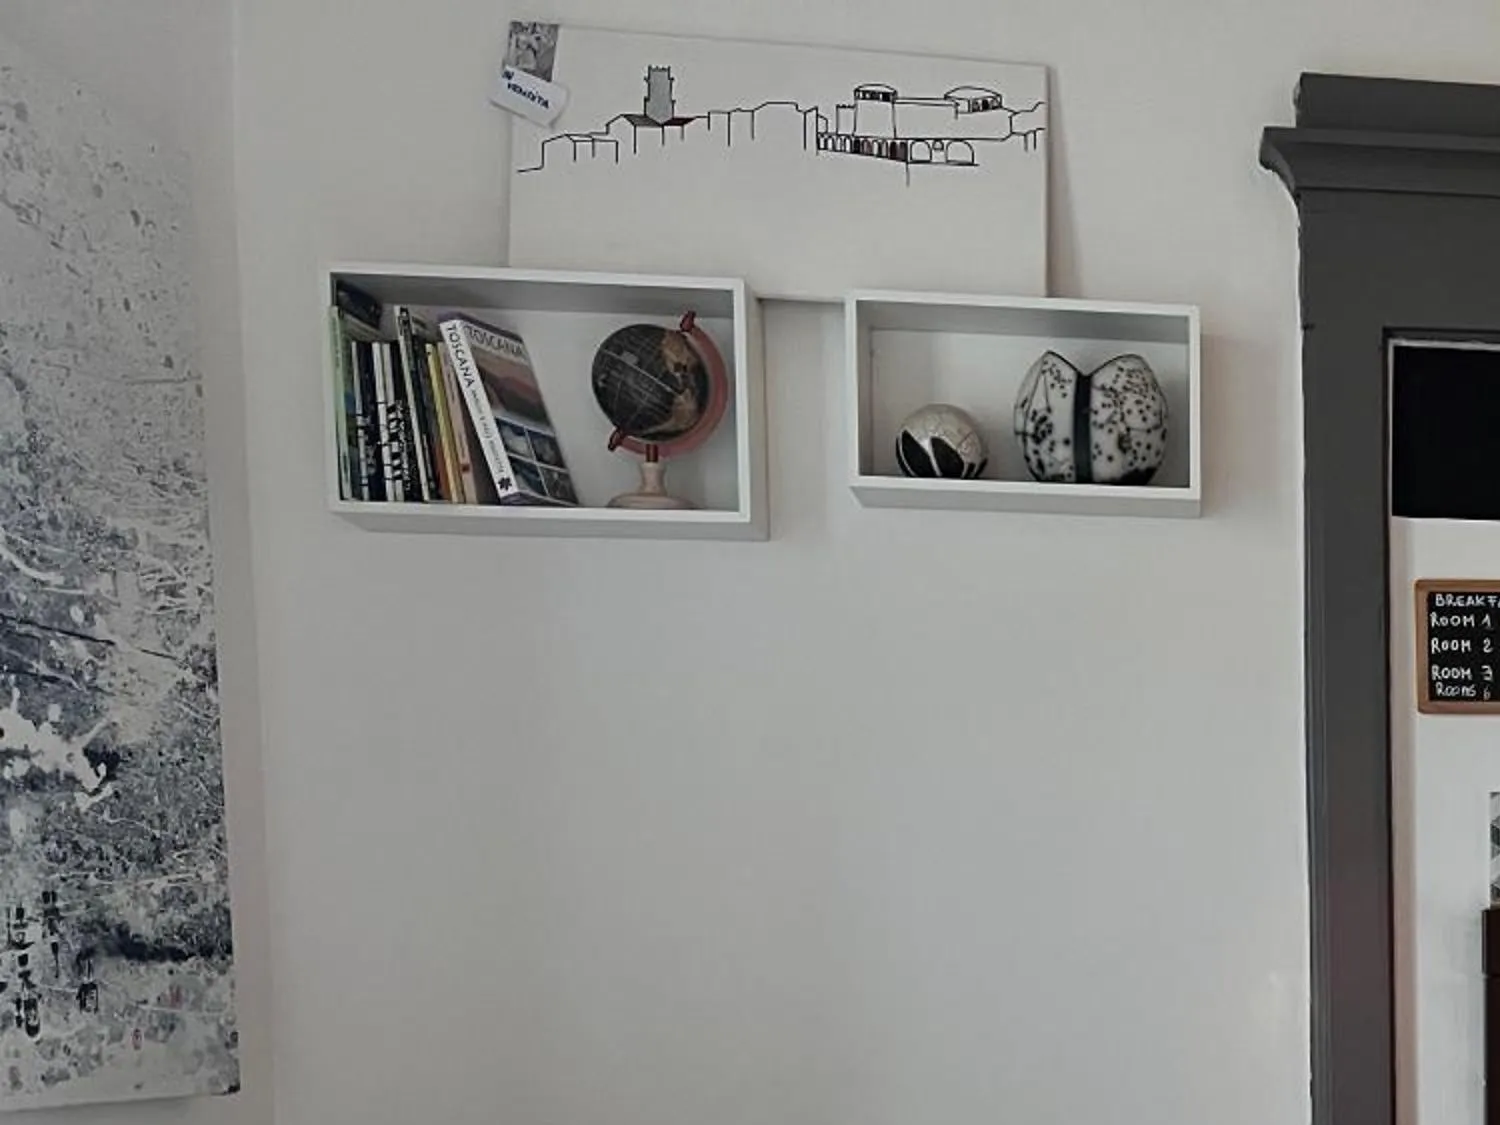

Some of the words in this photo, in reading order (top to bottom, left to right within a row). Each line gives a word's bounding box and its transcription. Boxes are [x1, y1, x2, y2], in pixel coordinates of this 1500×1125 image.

[1430, 611, 1475, 628] ROOM
[1481, 613, 1493, 630] 1
[1431, 637, 1472, 654] ROOM
[1482, 637, 1493, 653] 2
[1431, 664, 1473, 681] ROOM
[1481, 664, 1494, 682] 3
